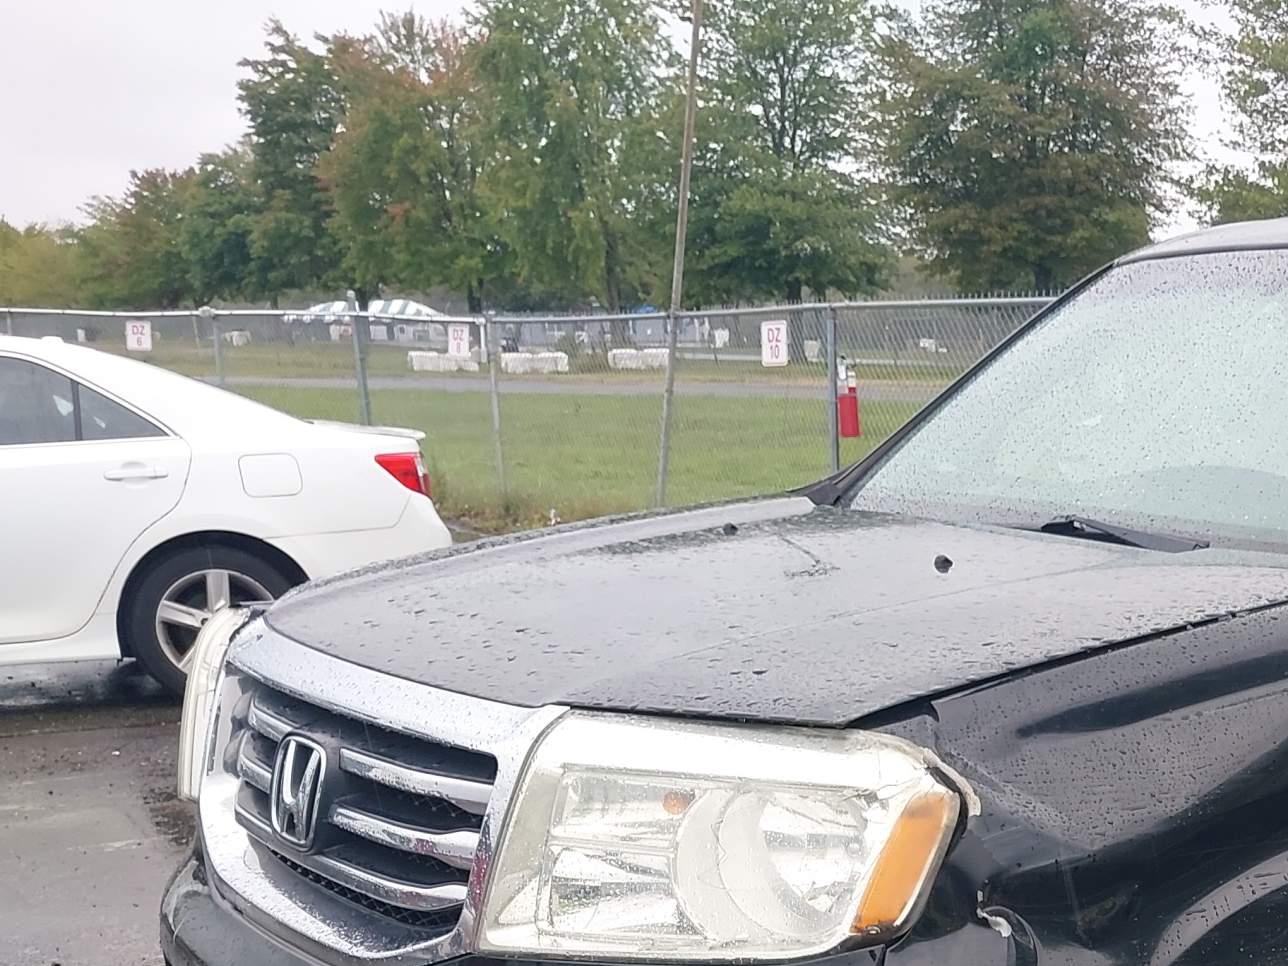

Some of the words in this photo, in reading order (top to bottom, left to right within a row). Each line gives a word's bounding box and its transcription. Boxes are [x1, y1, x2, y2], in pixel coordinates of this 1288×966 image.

[131, 325, 145, 336] DZ
[453, 328, 465, 341] DZ
[767, 327, 781, 343] DZ
[770, 344, 780, 359] 10
